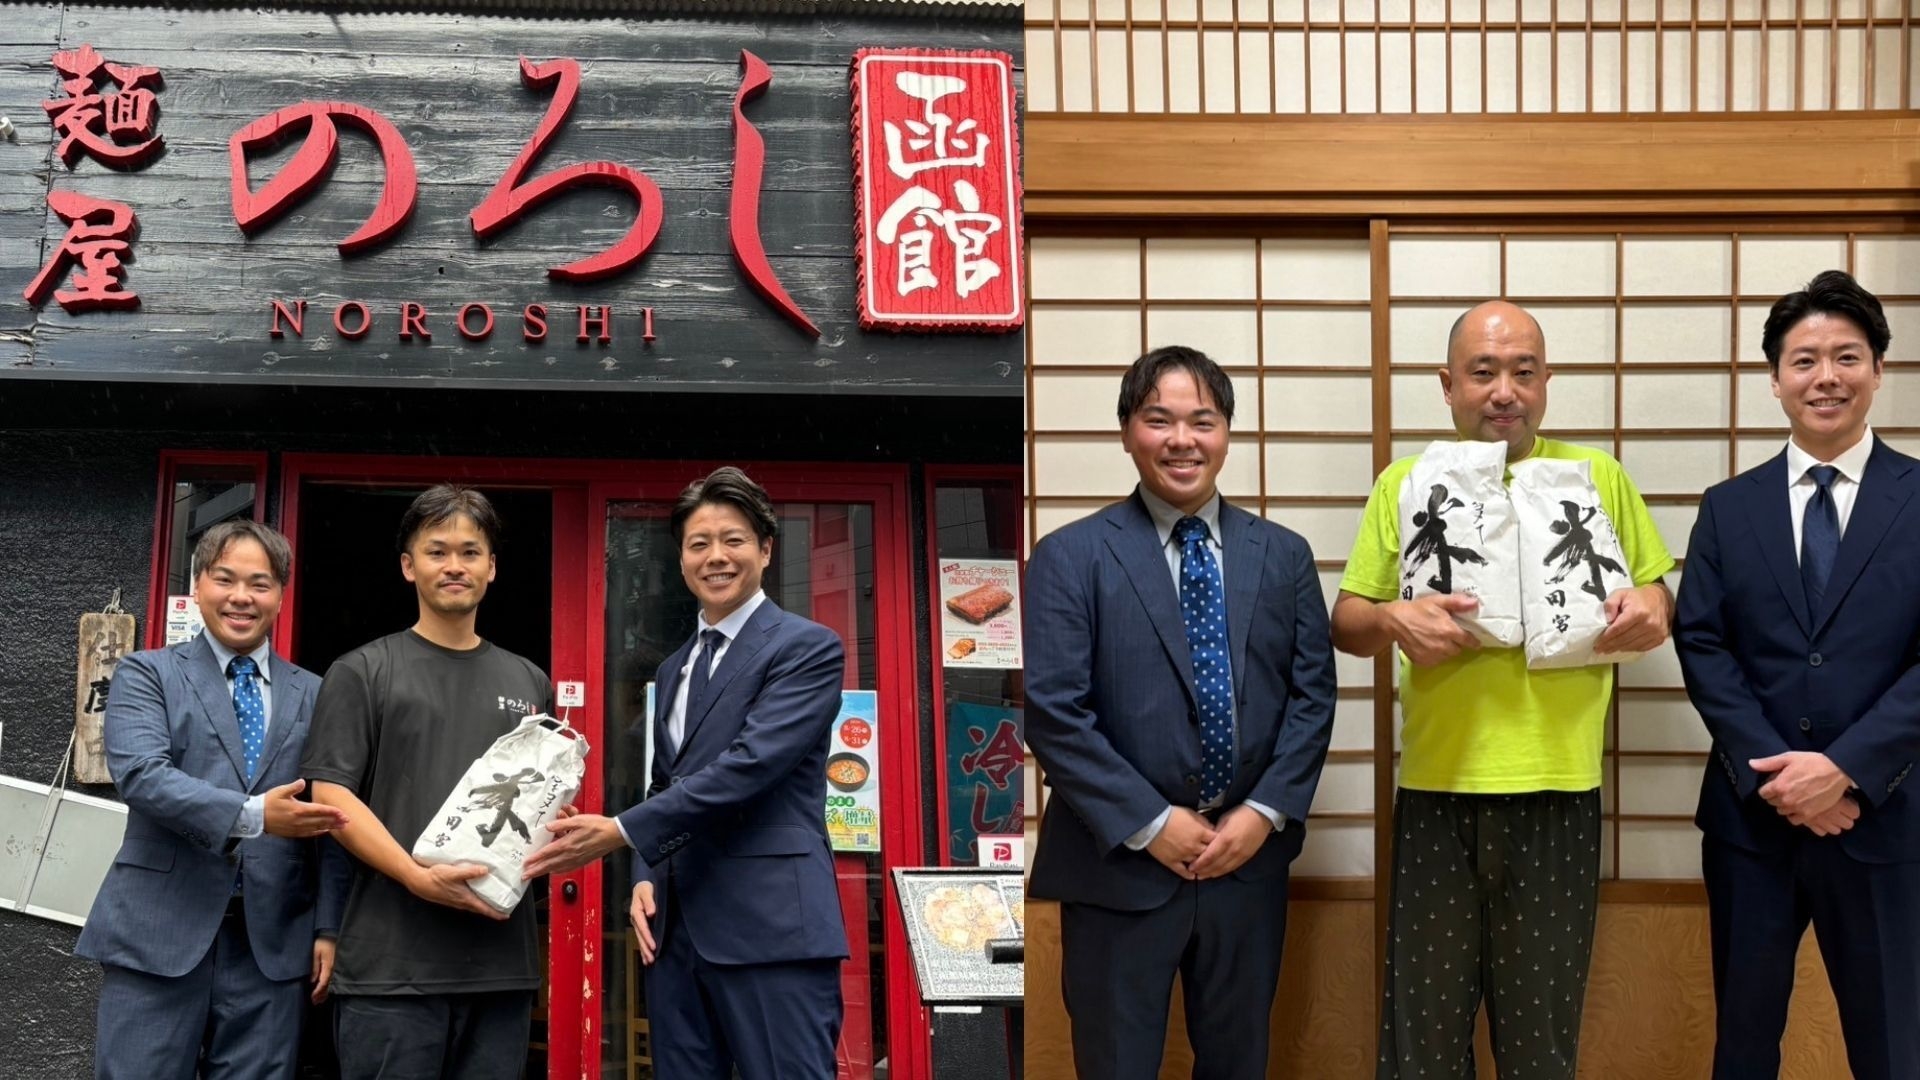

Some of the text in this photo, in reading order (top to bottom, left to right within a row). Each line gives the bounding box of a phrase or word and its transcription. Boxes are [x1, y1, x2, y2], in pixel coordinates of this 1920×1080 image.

[24, 43, 165, 312] 麺屋
[230, 48, 820, 338] のろし
[877, 71, 1002, 298] 函館
[270, 300, 656, 344] NOROSHI
